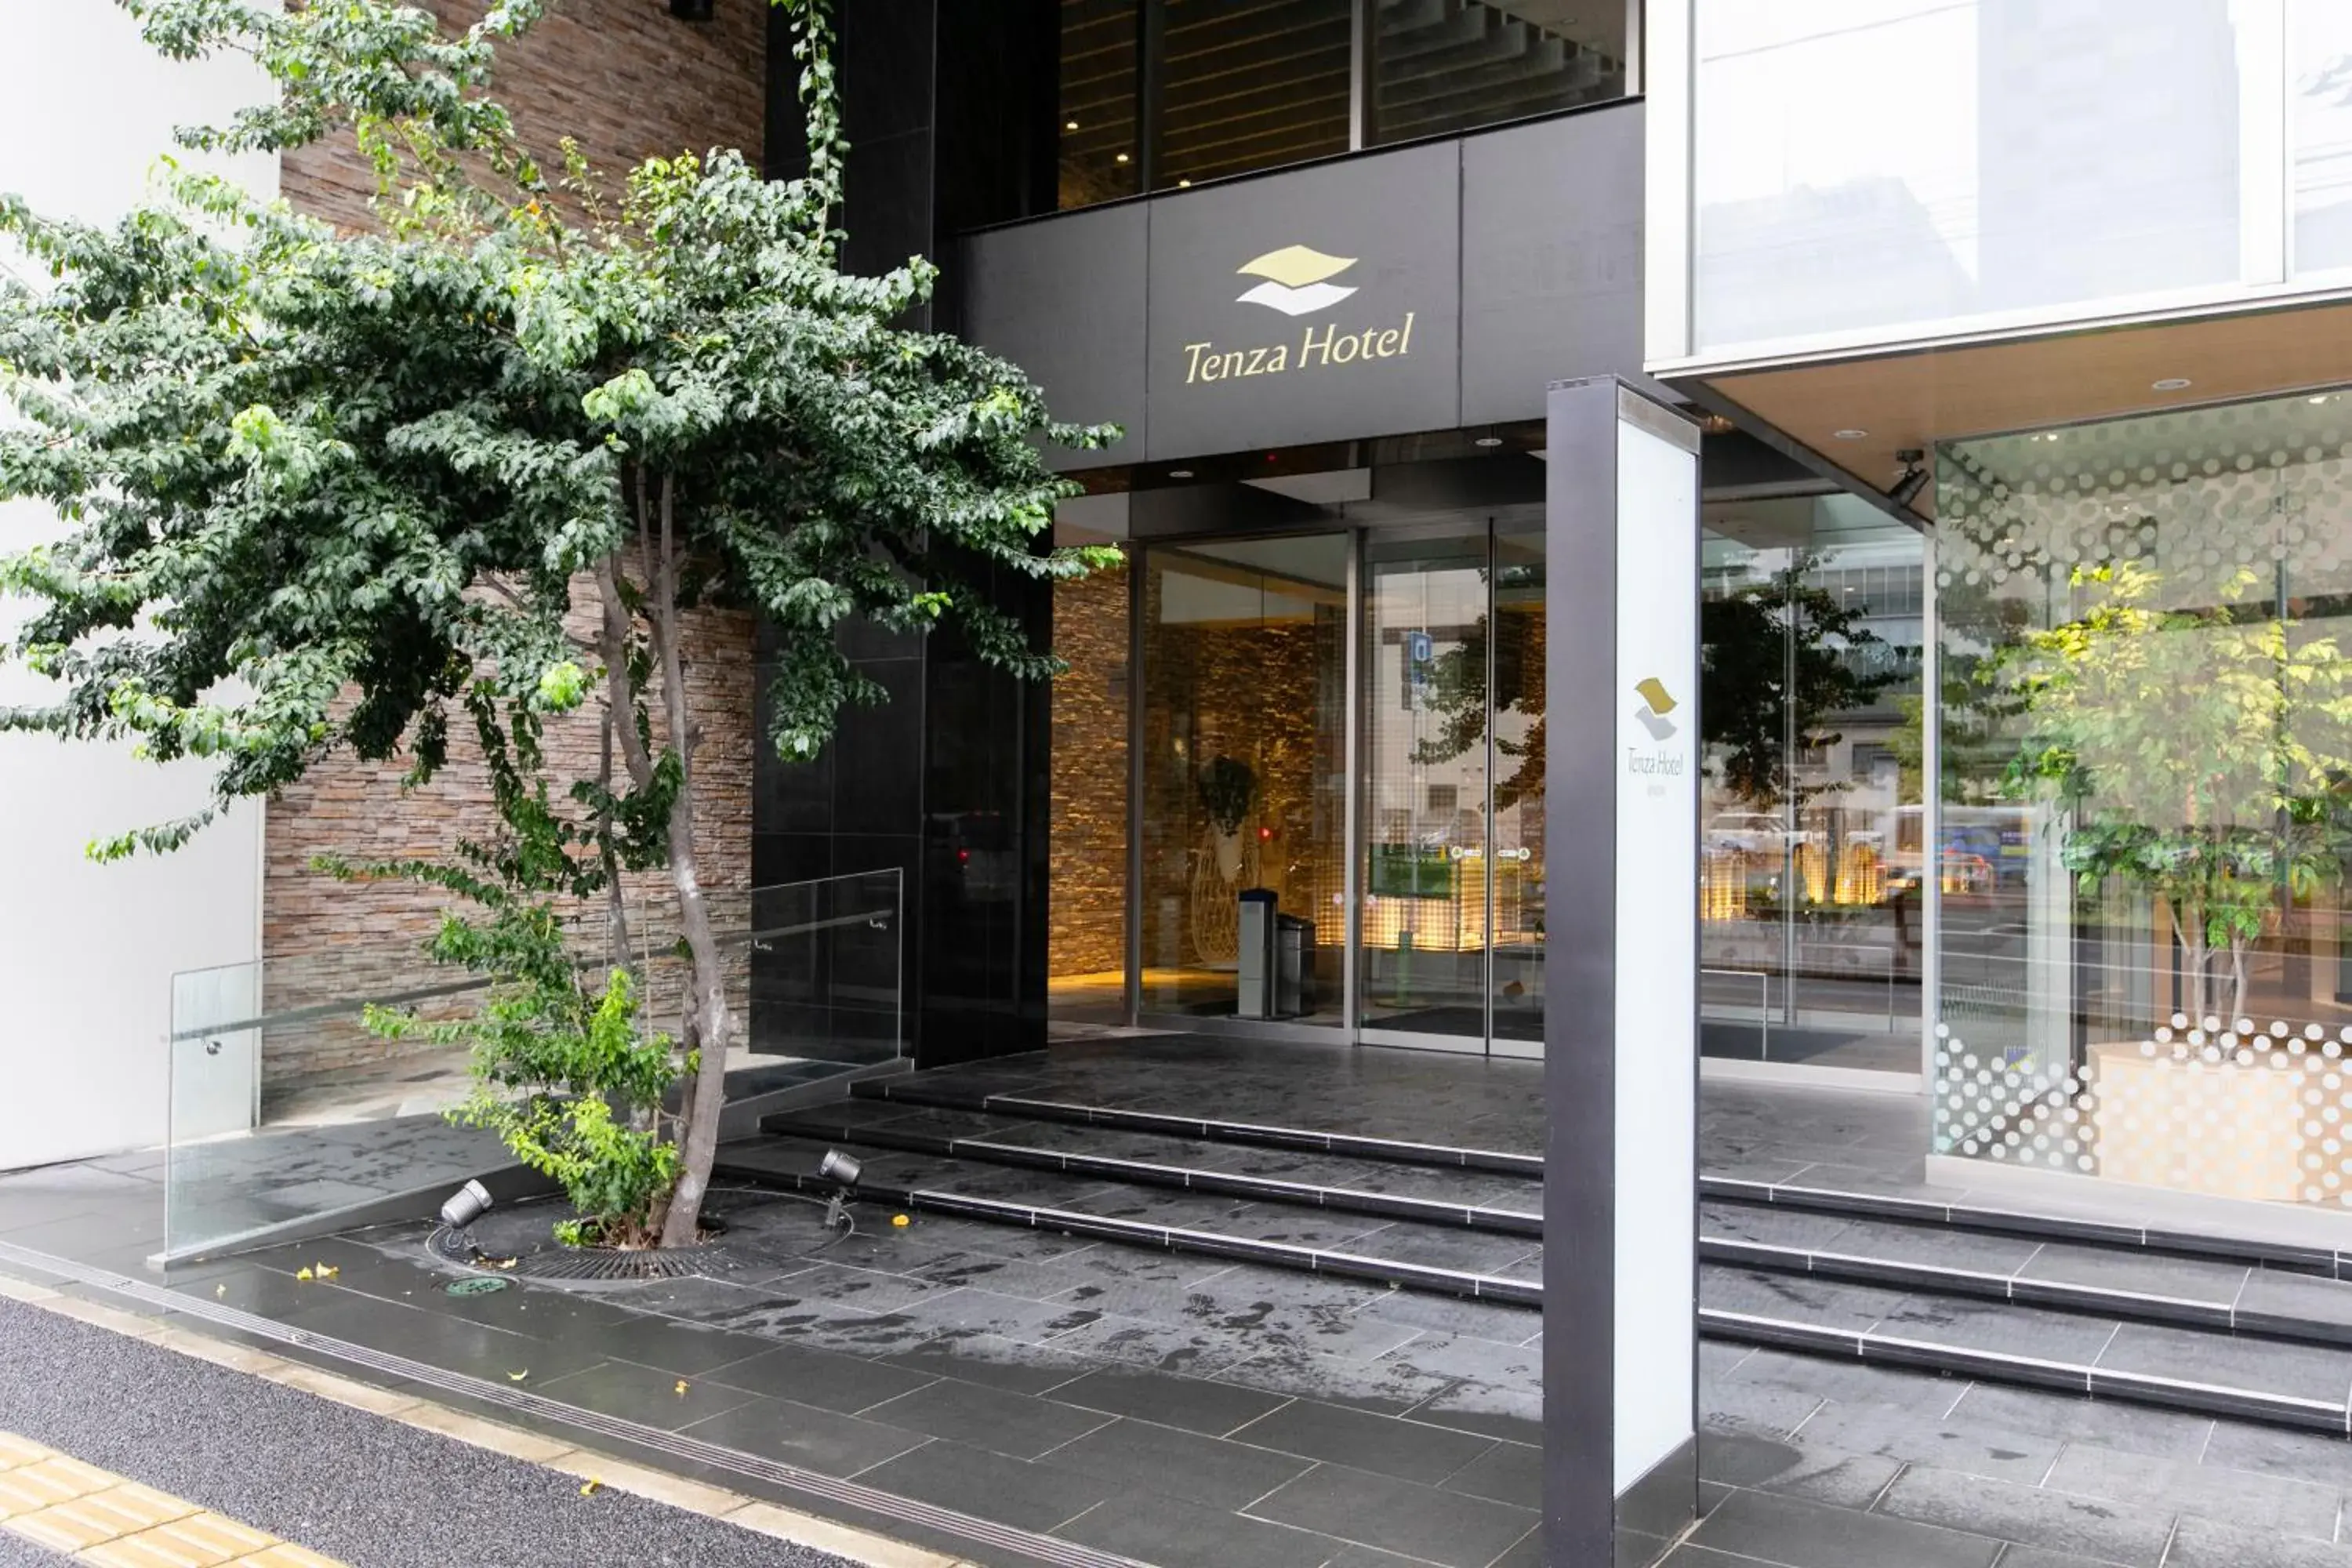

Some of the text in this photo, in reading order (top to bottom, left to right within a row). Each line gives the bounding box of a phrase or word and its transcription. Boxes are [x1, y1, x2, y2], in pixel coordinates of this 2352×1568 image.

[1184, 312, 1414, 383] Tenza Hotel
[1628, 746, 1683, 776] Tenza Hotel
